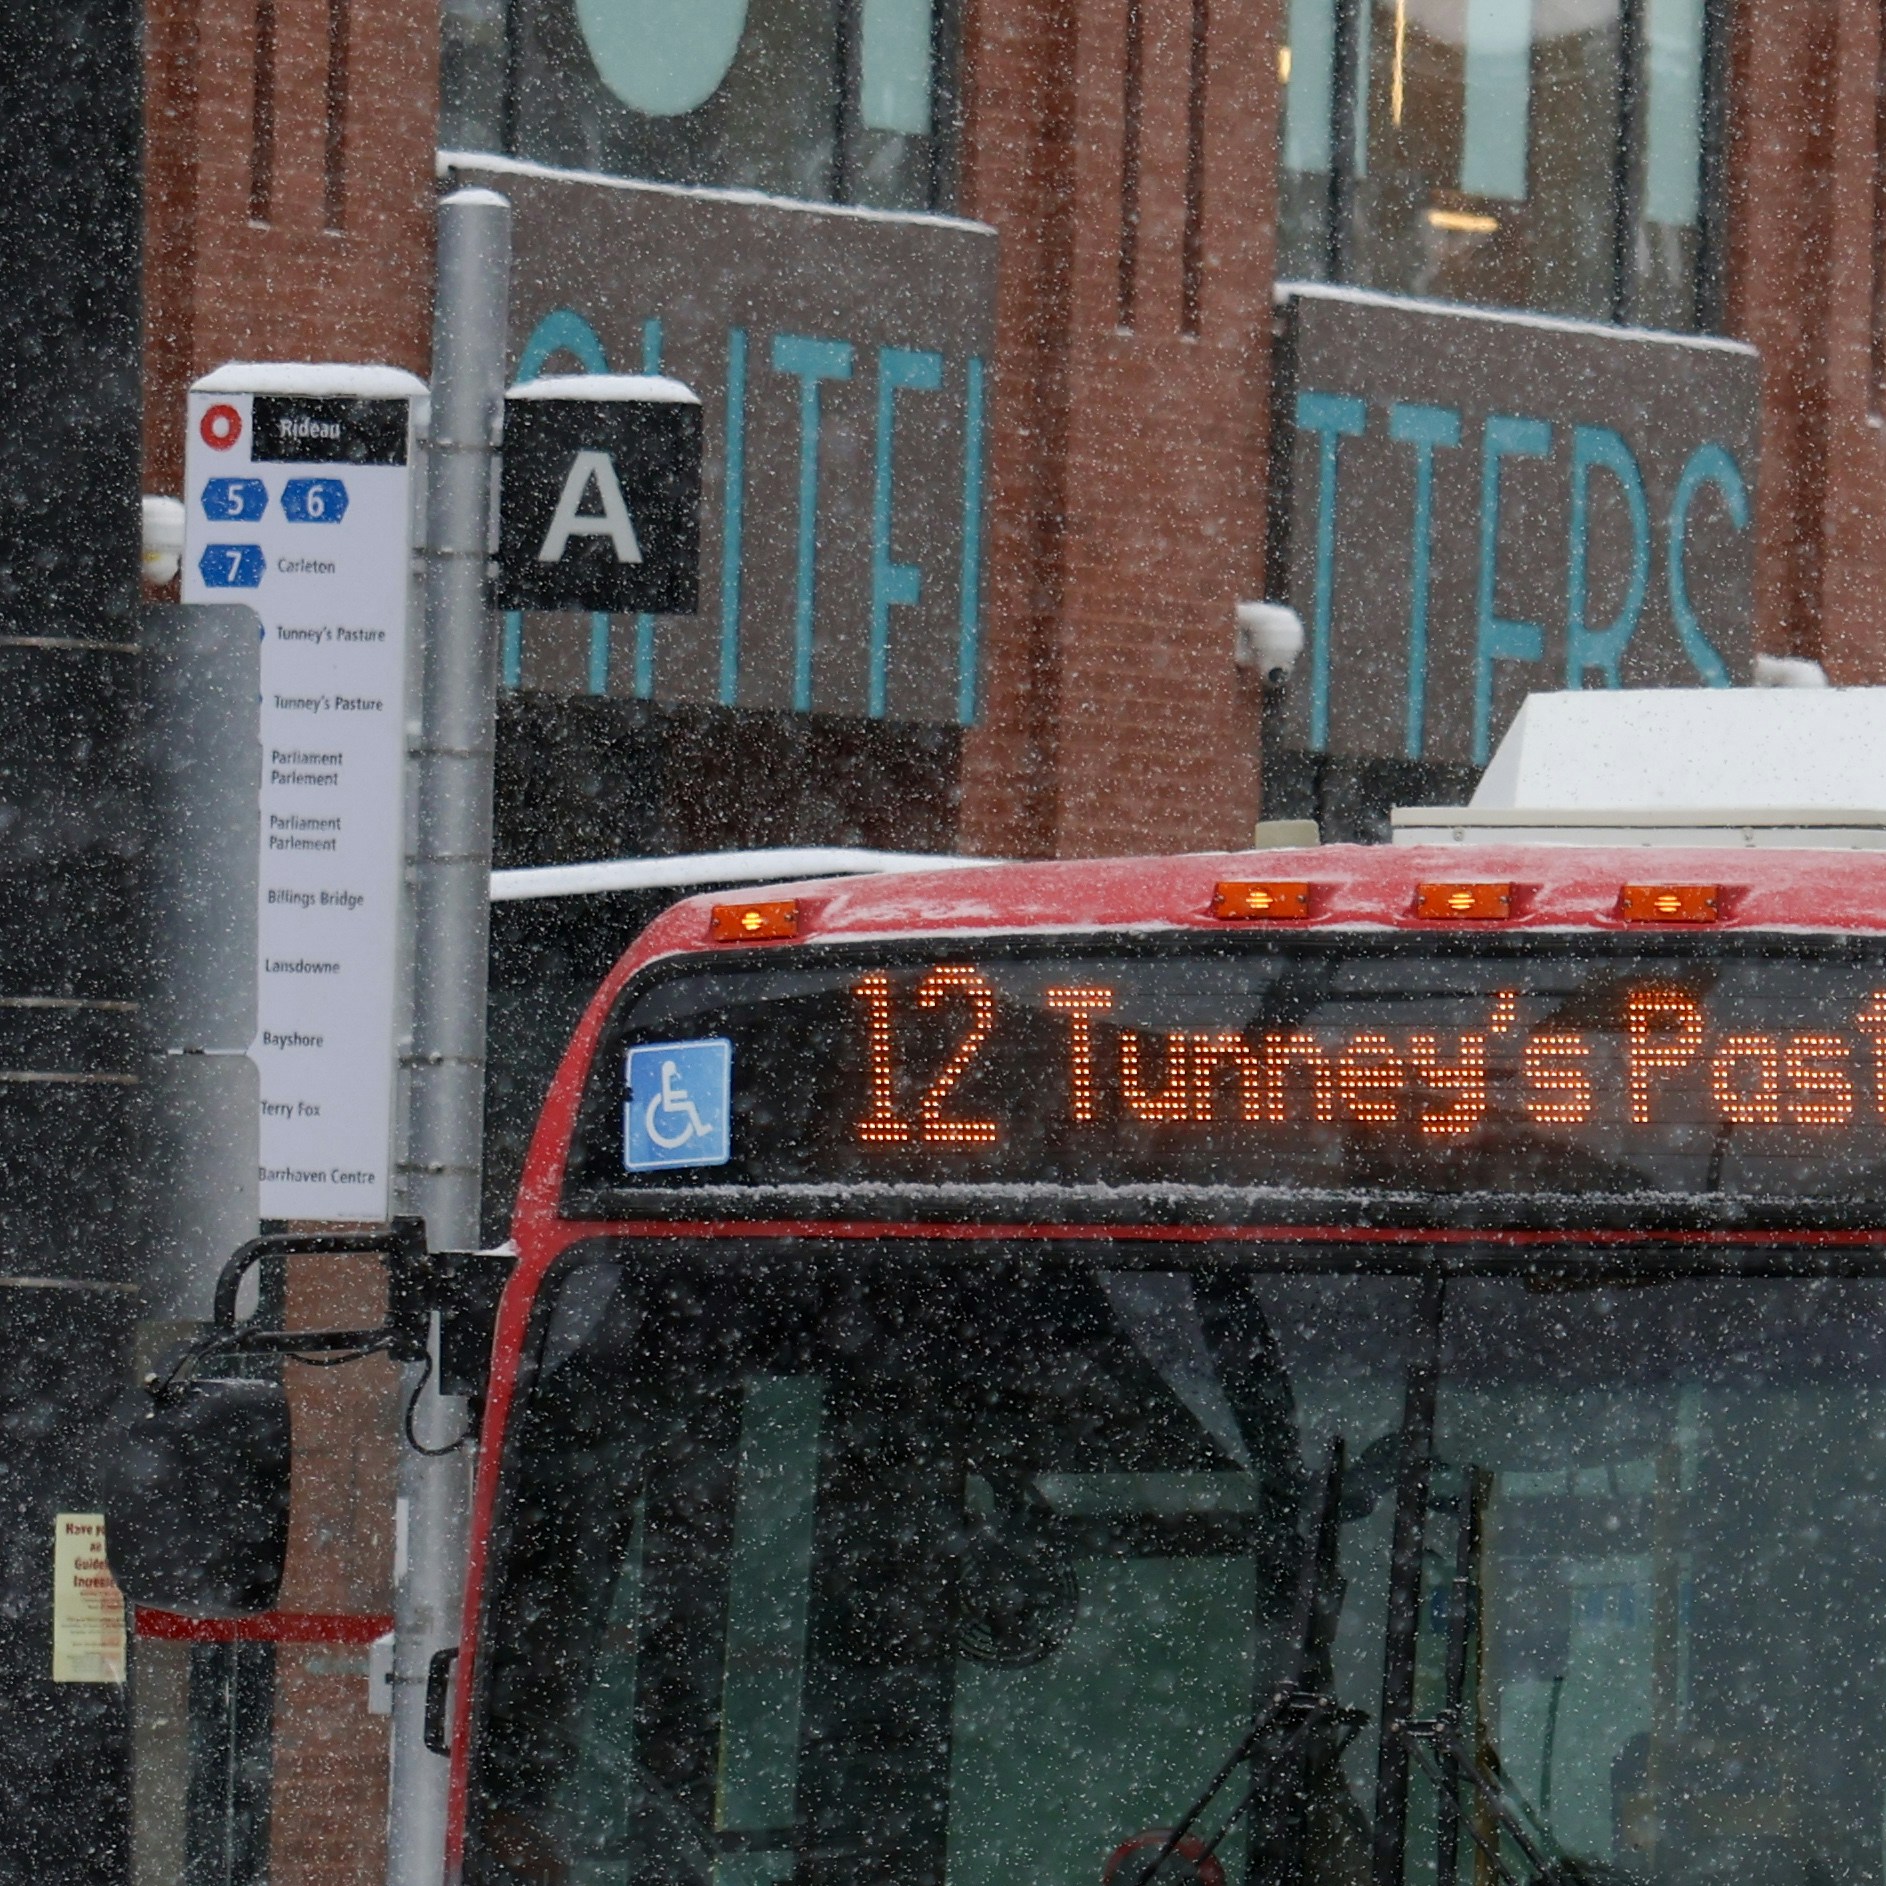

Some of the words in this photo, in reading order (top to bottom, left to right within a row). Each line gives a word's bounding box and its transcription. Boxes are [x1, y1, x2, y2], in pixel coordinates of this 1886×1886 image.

[279, 418, 340, 440] Rideau
[226, 484, 245, 516] 5
[306, 484, 325, 518] 6
[537, 450, 643, 565] A
[225, 551, 243, 582] 7
[277, 558, 336, 574] Carleton
[277, 626, 333, 645] Tunney's
[336, 627, 385, 643] Pasture
[274, 695, 330, 713] Tunney's
[334, 696, 383, 711] Pasture
[272, 750, 343, 765] Parliament
[271, 770, 338, 786] Parlement
[269, 815, 341, 830] Parliament
[269, 836, 336, 851] Parlement
[267, 890, 315, 908] Billings
[320, 891, 364, 910] Bridge
[265, 959, 340, 974] Lansdowne
[263, 1032, 324, 1049] Bayshore
[856, 966, 997, 1142] 12
[1047, 988, 1592, 1136] Tunney's
[261, 1101, 293, 1119] Terry
[298, 1102, 321, 1117] Fox
[258, 1167, 327, 1183] Barrhaven
[331, 1168, 375, 1184] Centre
